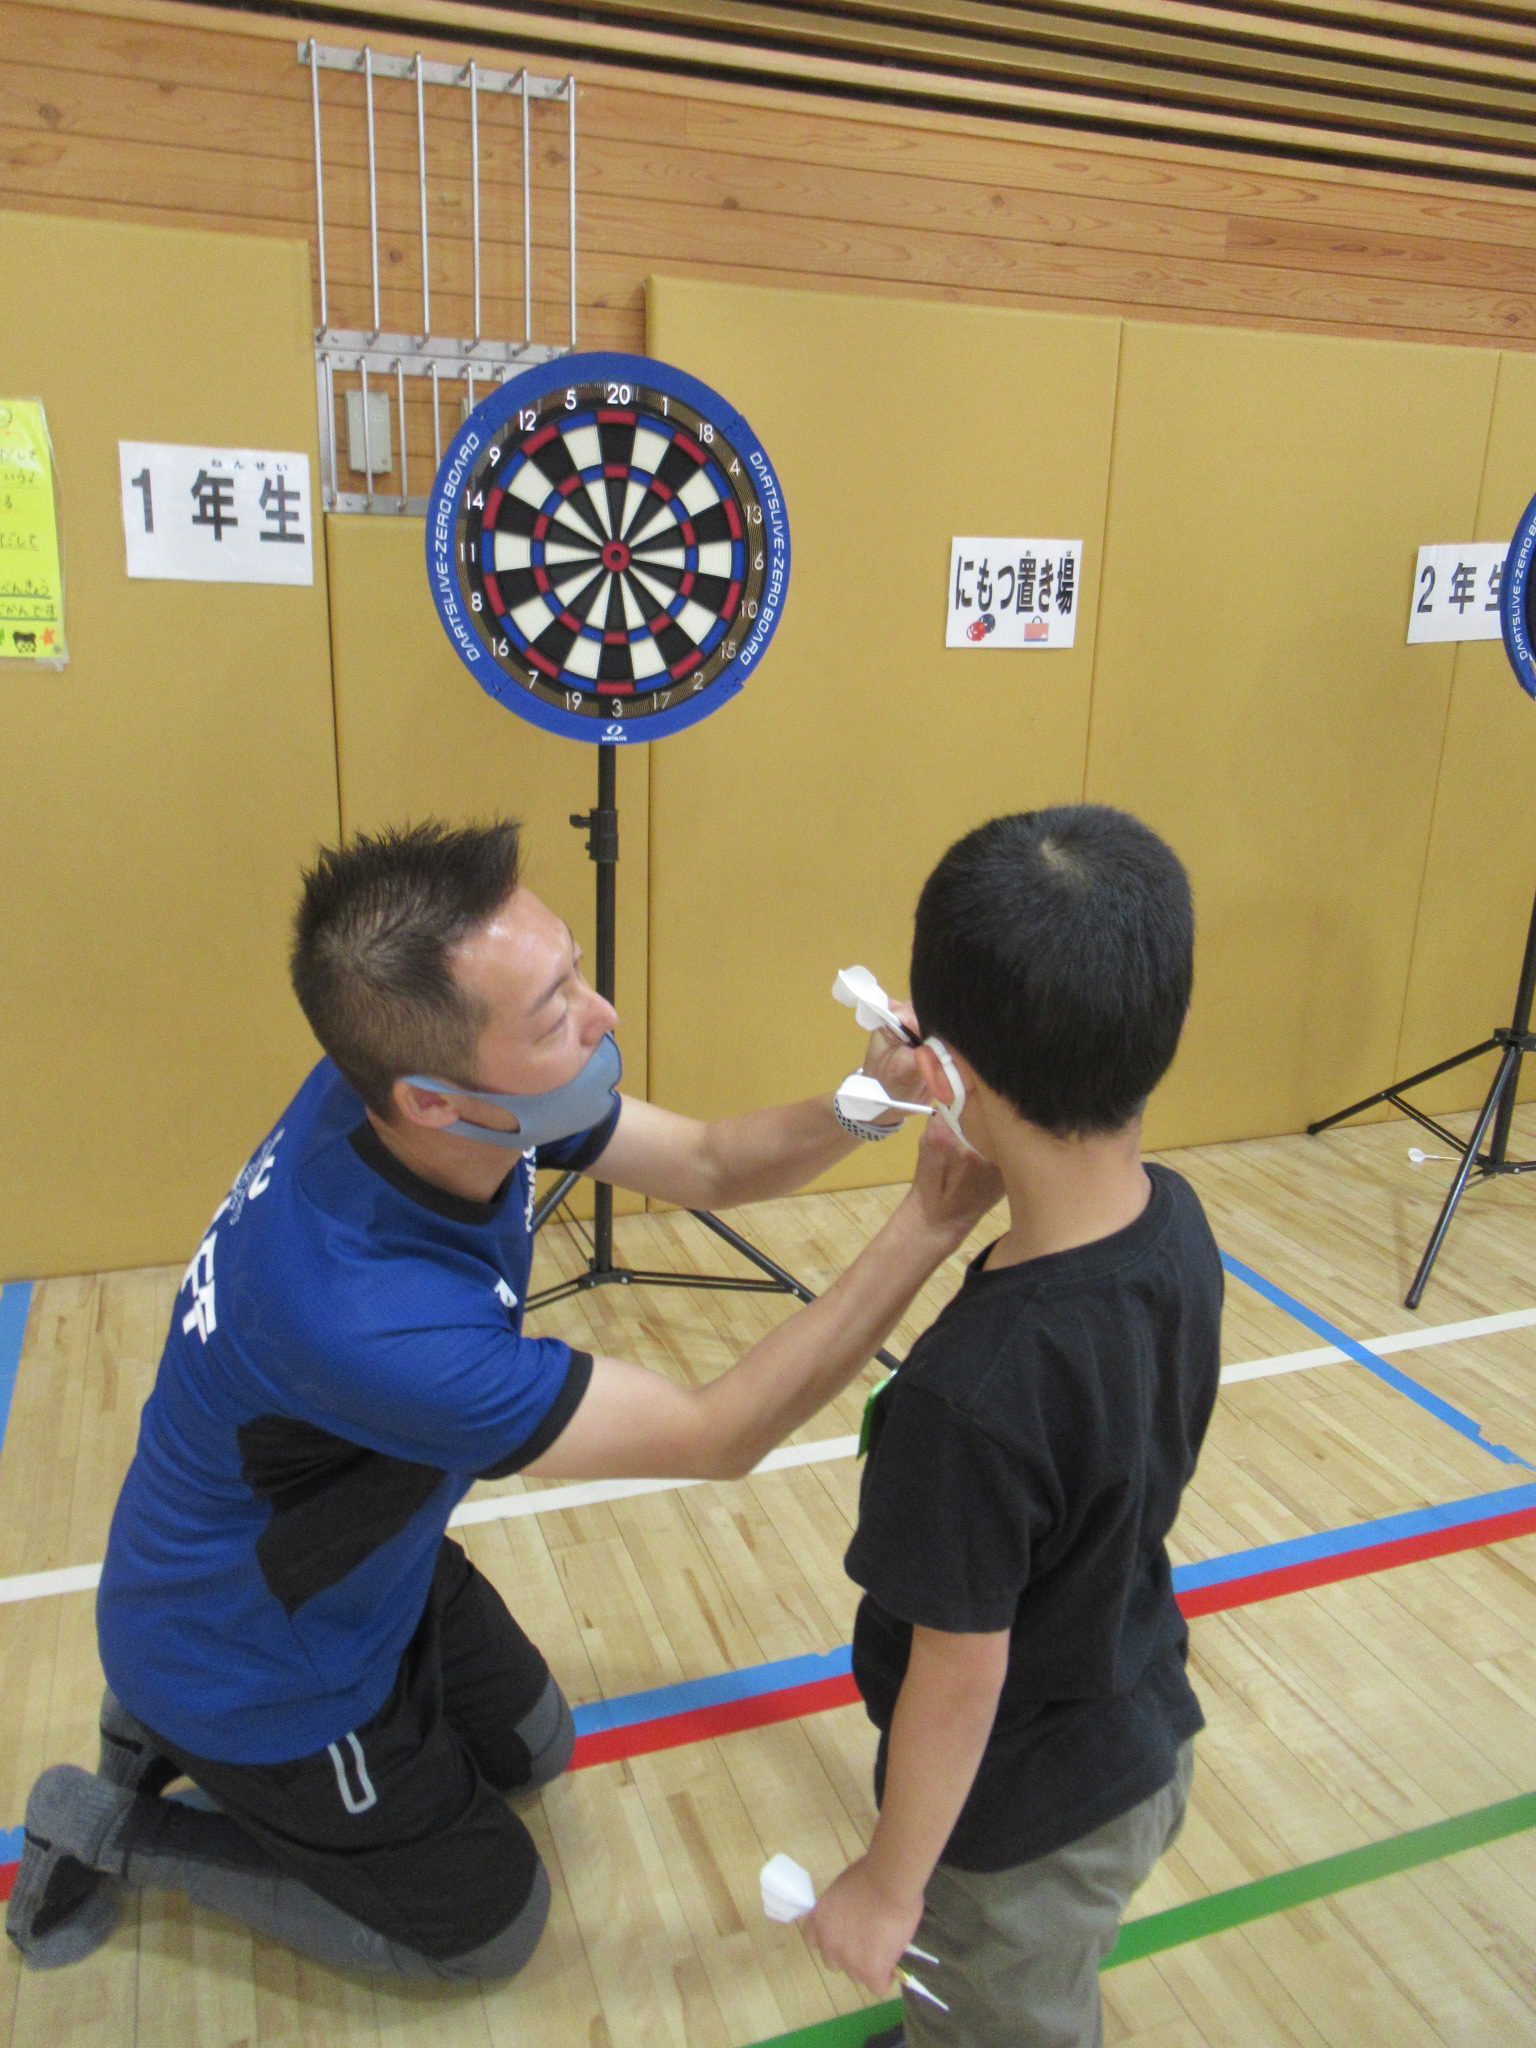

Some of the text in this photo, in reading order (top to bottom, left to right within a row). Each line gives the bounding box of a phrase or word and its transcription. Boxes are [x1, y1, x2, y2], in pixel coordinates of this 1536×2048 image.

[565, 389, 577, 410] 5
[607, 383, 631, 405] 20
[662, 396, 668, 416] 1
[519, 410, 537, 431] 12
[699, 423, 714, 444] 18
[443, 431, 481, 499] BOARD
[489, 446, 501, 467] 9
[730, 457, 740, 476] 4
[132, 468, 305, 545] 1年生
[466, 490, 484, 511] 14
[746, 505, 763, 525] 13
[460, 542, 475, 563] 11
[754, 552, 764, 570] 6
[955, 555, 1075, 615] にもつ置き場
[471, 592, 483, 612] 8
[741, 601, 758, 619] 10
[740, 606, 774, 666] BOARD
[492, 637, 509, 657] 16
[721, 640, 736, 659] 15
[528, 670, 539, 689] 7
[693, 672, 704, 690] 2
[565, 691, 582, 711] 19
[612, 698, 623, 718] 3
[653, 692, 671, 710] 17
